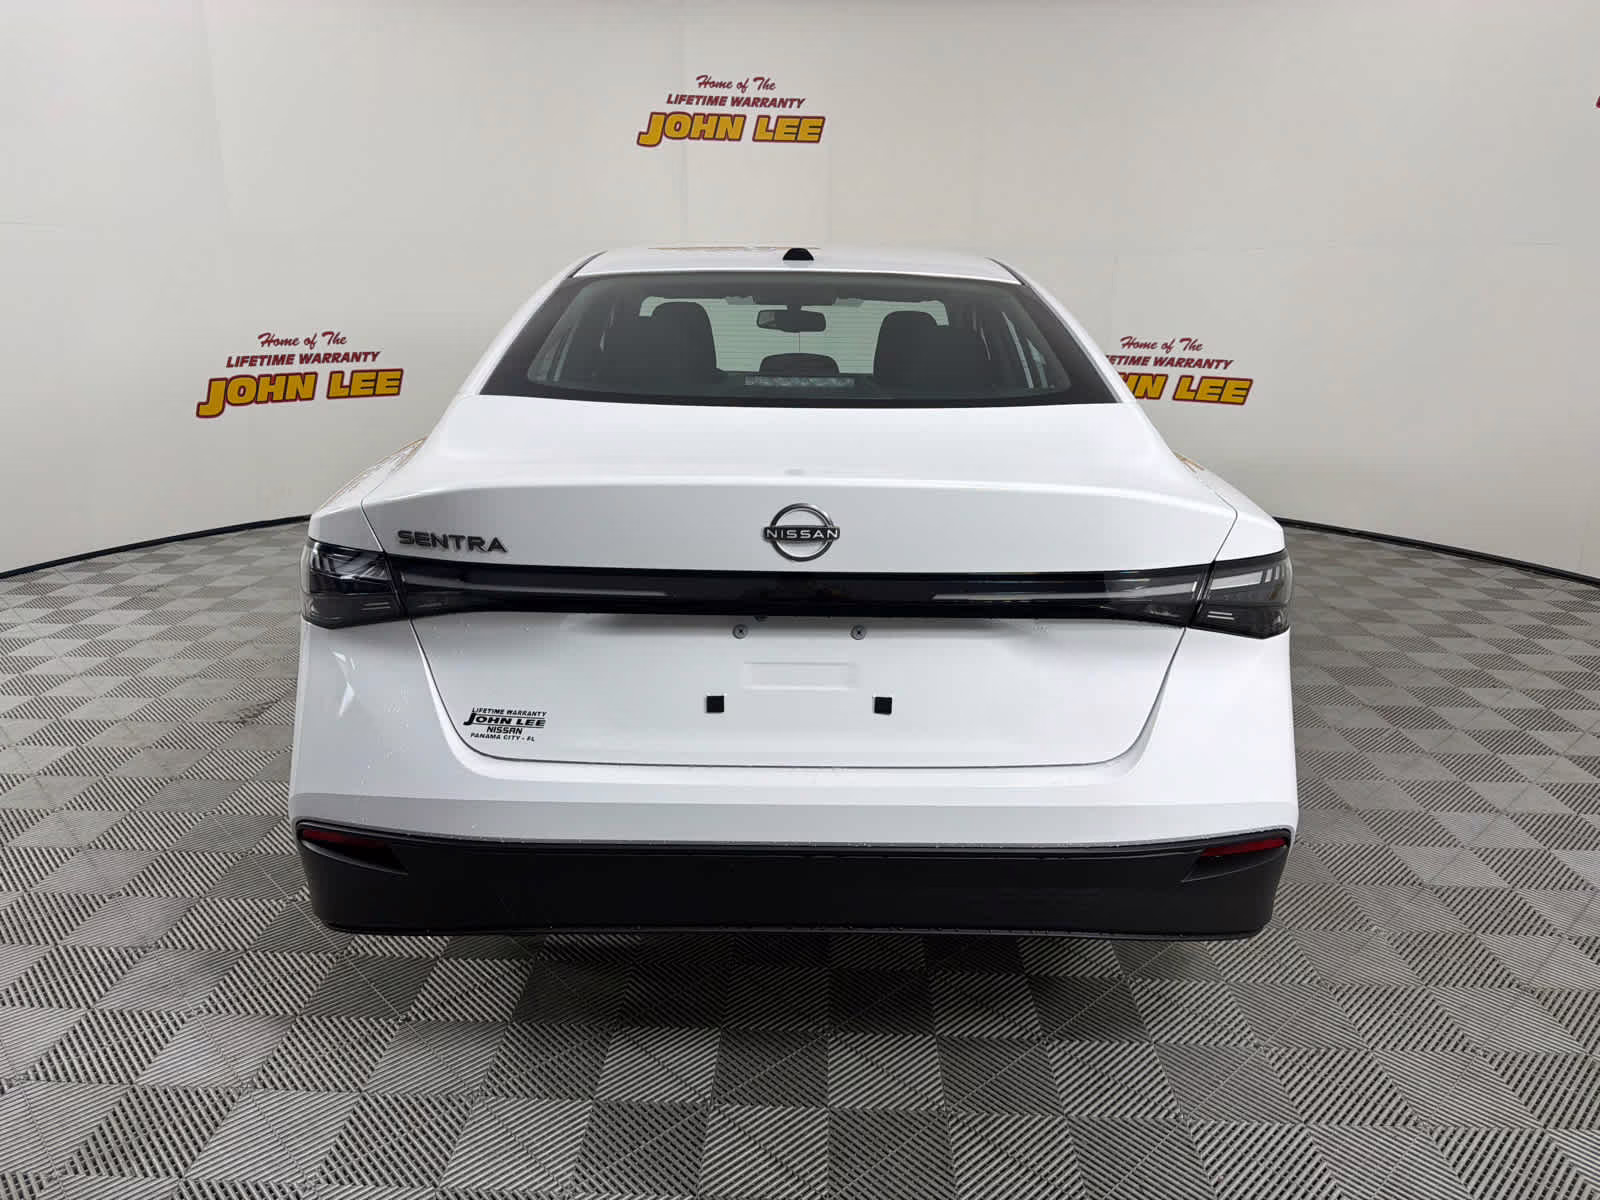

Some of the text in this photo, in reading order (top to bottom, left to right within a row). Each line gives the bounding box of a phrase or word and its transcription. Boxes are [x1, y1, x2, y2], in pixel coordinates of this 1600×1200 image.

[696, 74, 777, 94] Home of The
[666, 93, 806, 109] LIFETIME WARRANTY
[637, 110, 826, 147] JOHN LEE
[257, 331, 347, 350] Home of The
[1120, 335, 1204, 354] Home of The
[226, 351, 381, 368] LIFETIME WARRANTY
[1152, 356, 1234, 370] WARRANTY
[196, 368, 404, 418] JOHN LEE
[1172, 375, 1253, 405] LEE
[397, 529, 508, 553] SENTRA
[765, 529, 838, 539] NISSAN
[463, 712, 546, 727] JOHN LEE
[472, 707, 548, 717] LIFETIME WARRANTY
[470, 732, 501, 740] PANAMA
[486, 726, 523, 735] NISSAN
